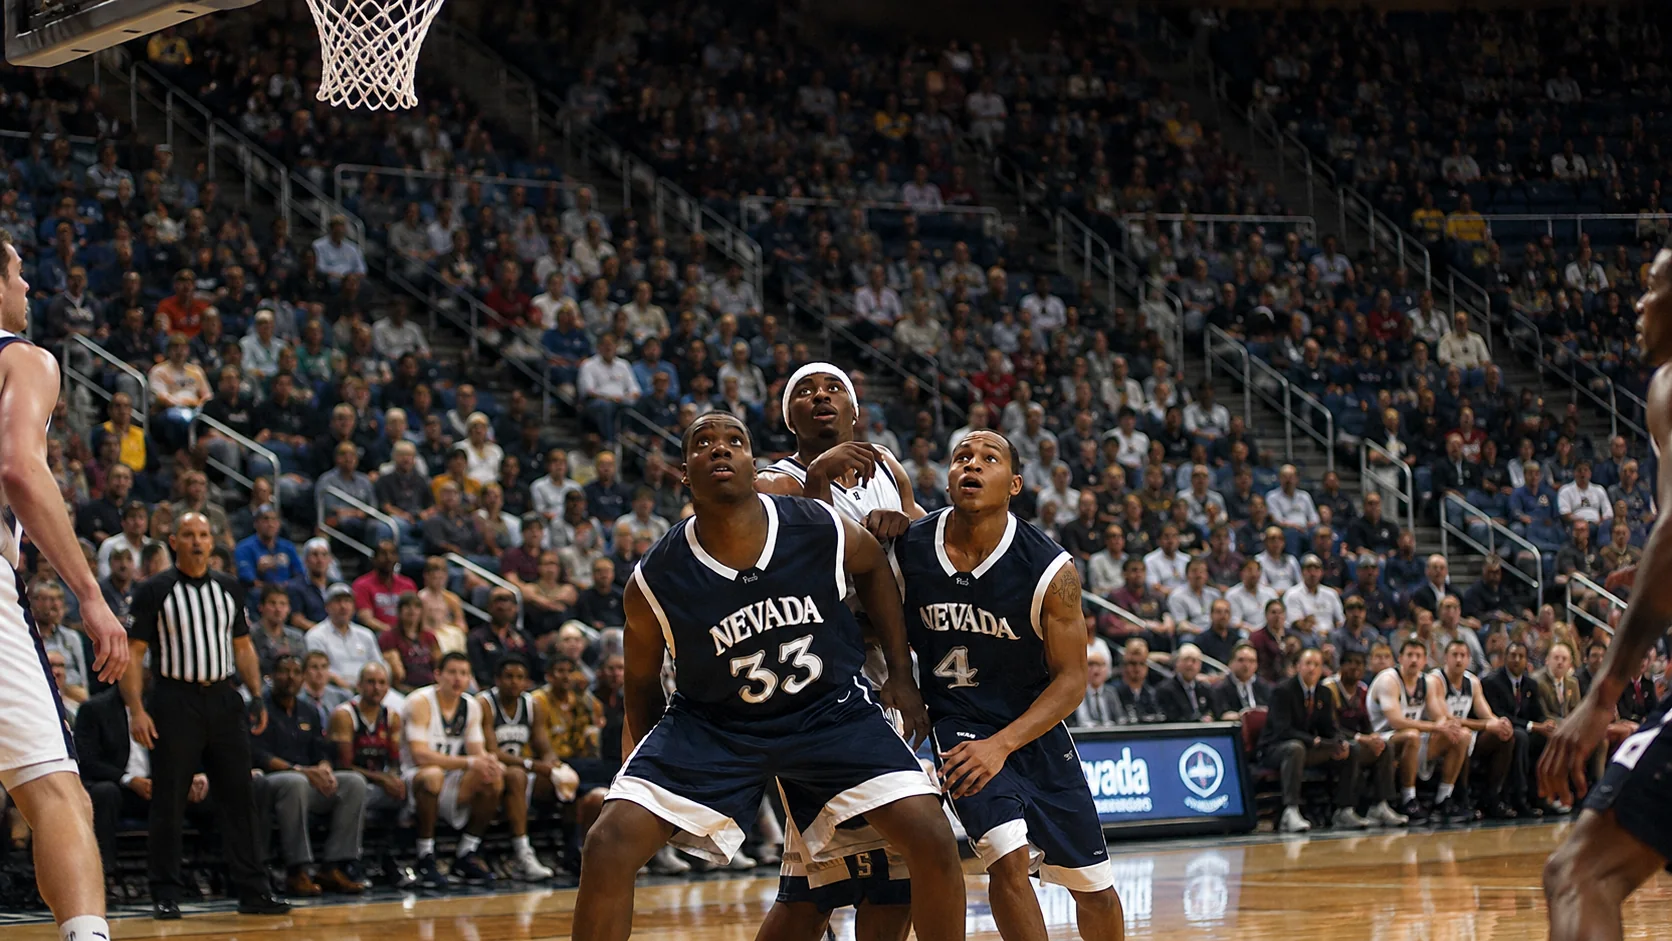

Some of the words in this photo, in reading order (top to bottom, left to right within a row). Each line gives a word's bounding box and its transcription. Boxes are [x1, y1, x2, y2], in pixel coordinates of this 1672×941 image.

[709, 595, 824, 656] NEVADA
[919, 602, 1021, 640] NEVADA
[729, 633, 824, 703] 33
[932, 645, 980, 689] 4
